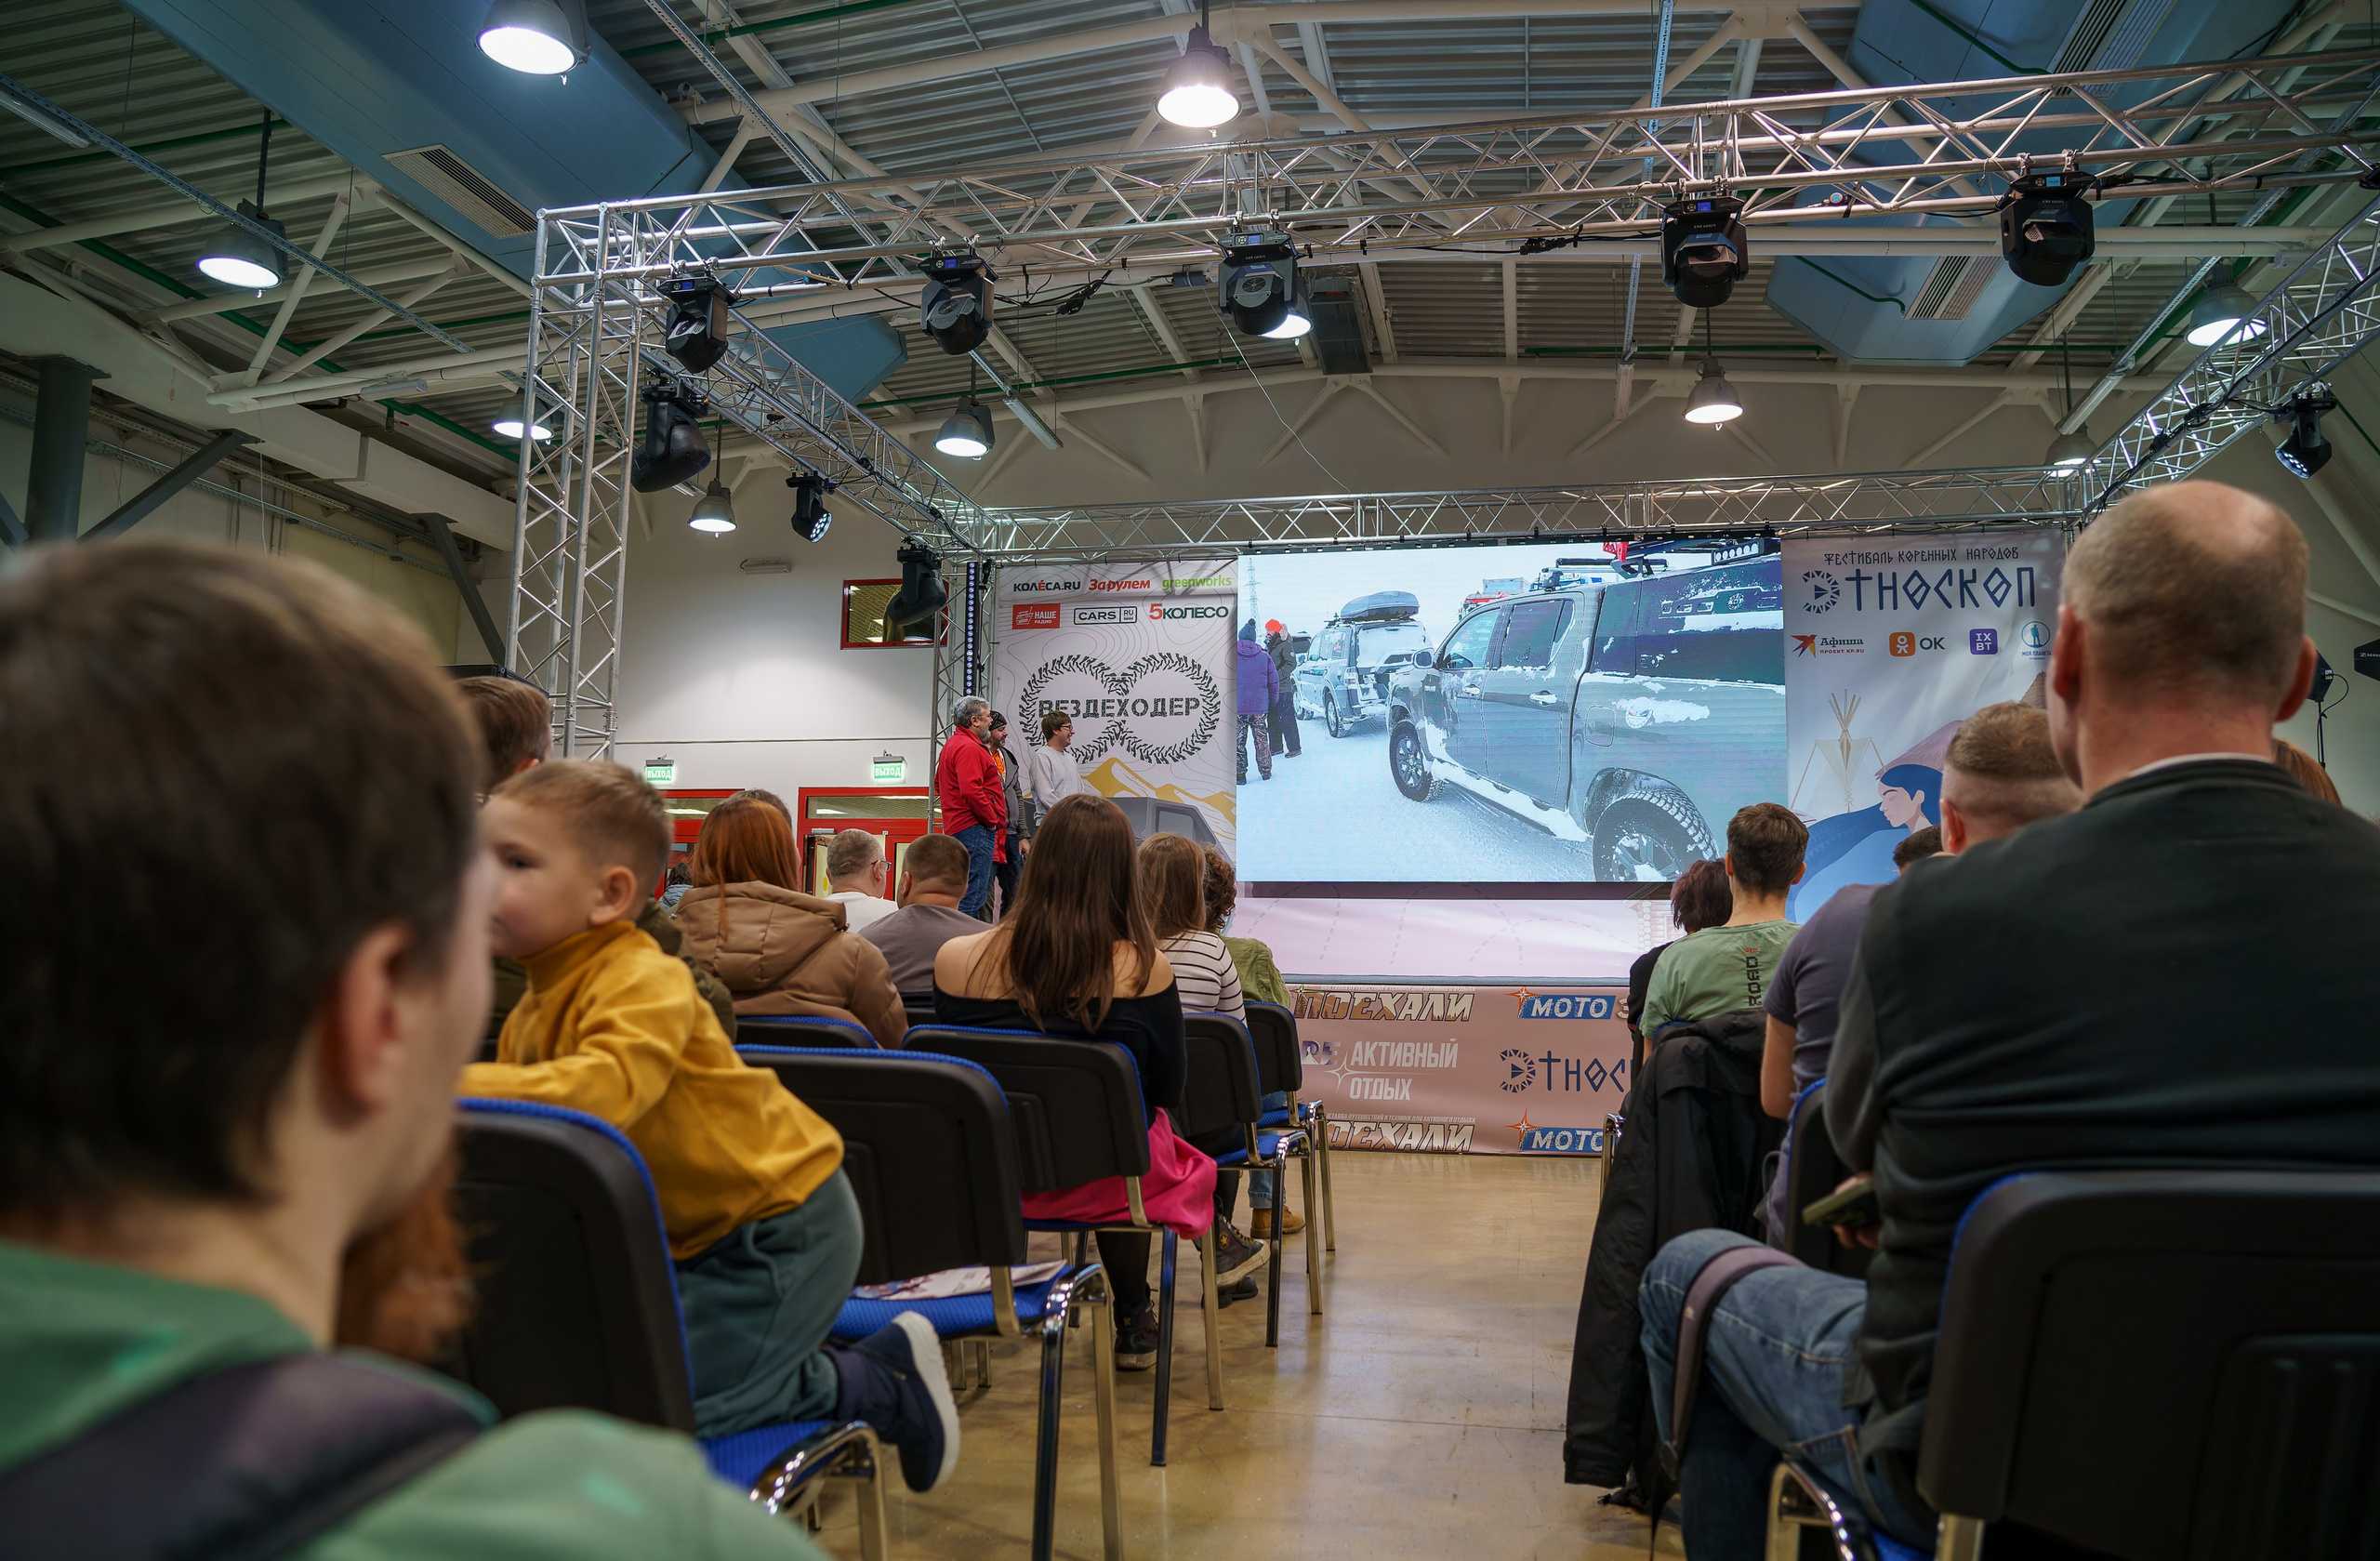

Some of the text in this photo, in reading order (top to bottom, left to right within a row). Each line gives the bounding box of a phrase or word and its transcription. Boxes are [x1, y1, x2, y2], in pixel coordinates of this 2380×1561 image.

[1824, 547, 2019, 565] ФЕСТИВАЛЬ КОРЕННЫХ НАРОДОВ
[1162, 575, 1232, 590] greenworks
[1034, 611, 1057, 619] НАШЕ
[1078, 611, 1117, 620] CARS
[1819, 637, 1864, 648] Афиша
[1920, 637, 1945, 650] OK
[1976, 633, 1991, 642] IX
[1976, 642, 1992, 651] BT
[1038, 697, 1200, 719] ВЕЗДЕХОДЕР
[647, 770, 671, 780] ВЫХОД
[875, 767, 901, 777] ВЫХОД
[1293, 991, 1475, 1022] ПОЕХАЛИ
[1531, 997, 1607, 1018] МОТО
[1350, 1038, 1459, 1068] АКТИВНЫЙ
[1349, 1077, 1412, 1100] ОТДЫХ
[1315, 1119, 1475, 1153] ОЕХАЛИ
